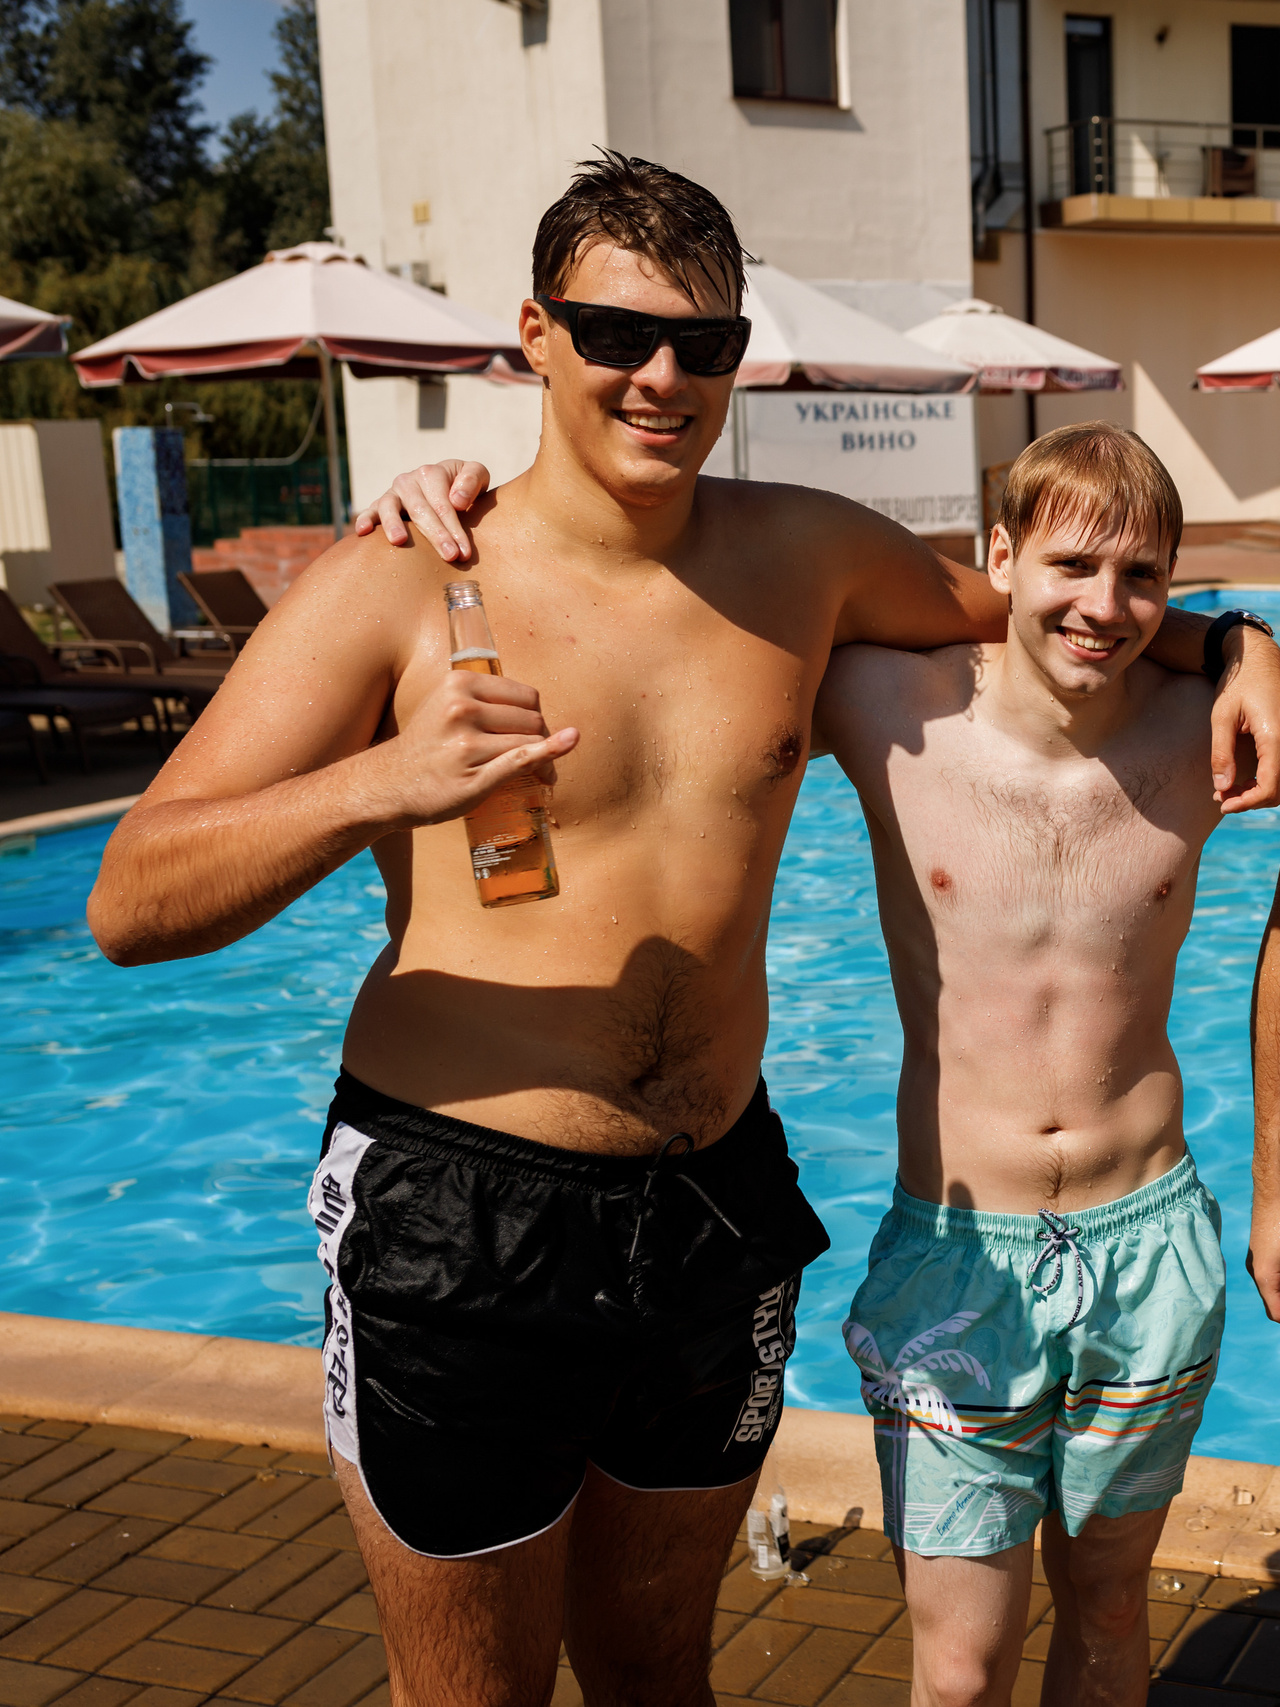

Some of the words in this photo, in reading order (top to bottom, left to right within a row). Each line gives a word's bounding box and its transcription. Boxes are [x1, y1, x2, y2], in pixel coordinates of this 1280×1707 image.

[796, 401, 955, 421] УКРАЇНСЬКЕ
[841, 430, 916, 451] ВИНО
[1074, 1254, 1083, 1288] ARMANI
[936, 1511, 956, 1536] Emporio
[956, 1489, 976, 1512] Armani
